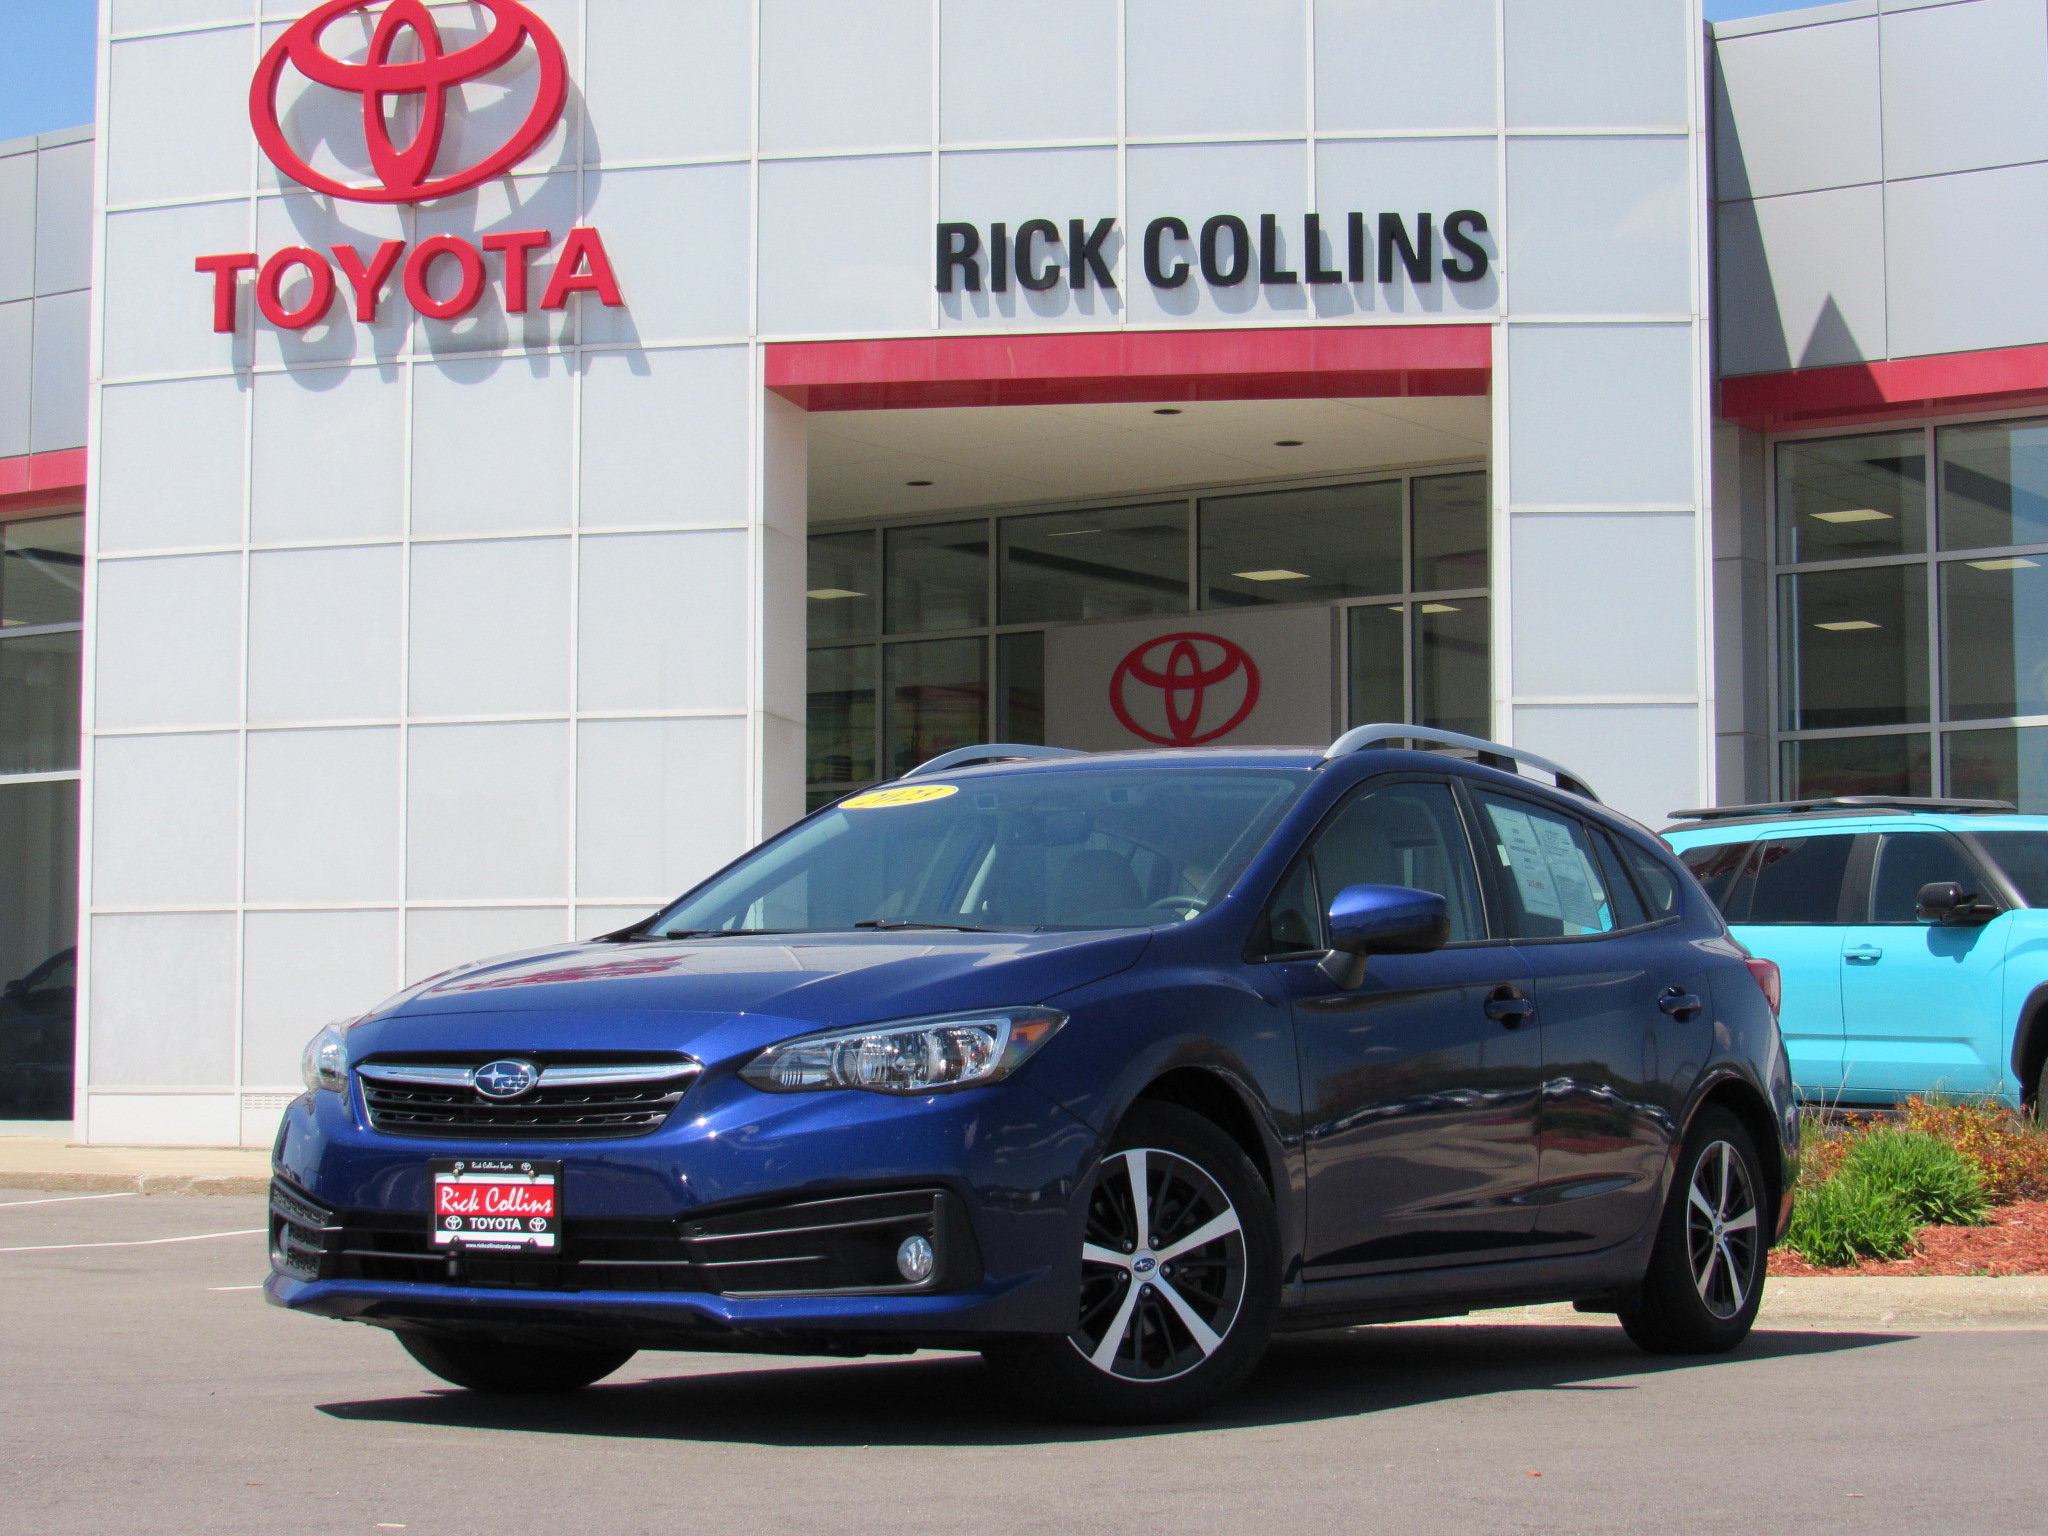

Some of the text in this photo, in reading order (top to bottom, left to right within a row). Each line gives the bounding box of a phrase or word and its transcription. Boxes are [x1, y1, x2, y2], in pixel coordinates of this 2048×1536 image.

[936, 209, 1489, 293] RICK COLLINS
[195, 227, 626, 334] TOYOTA
[441, 1186, 552, 1214] Rick Collins
[470, 1217, 521, 1230] TOYOTA
